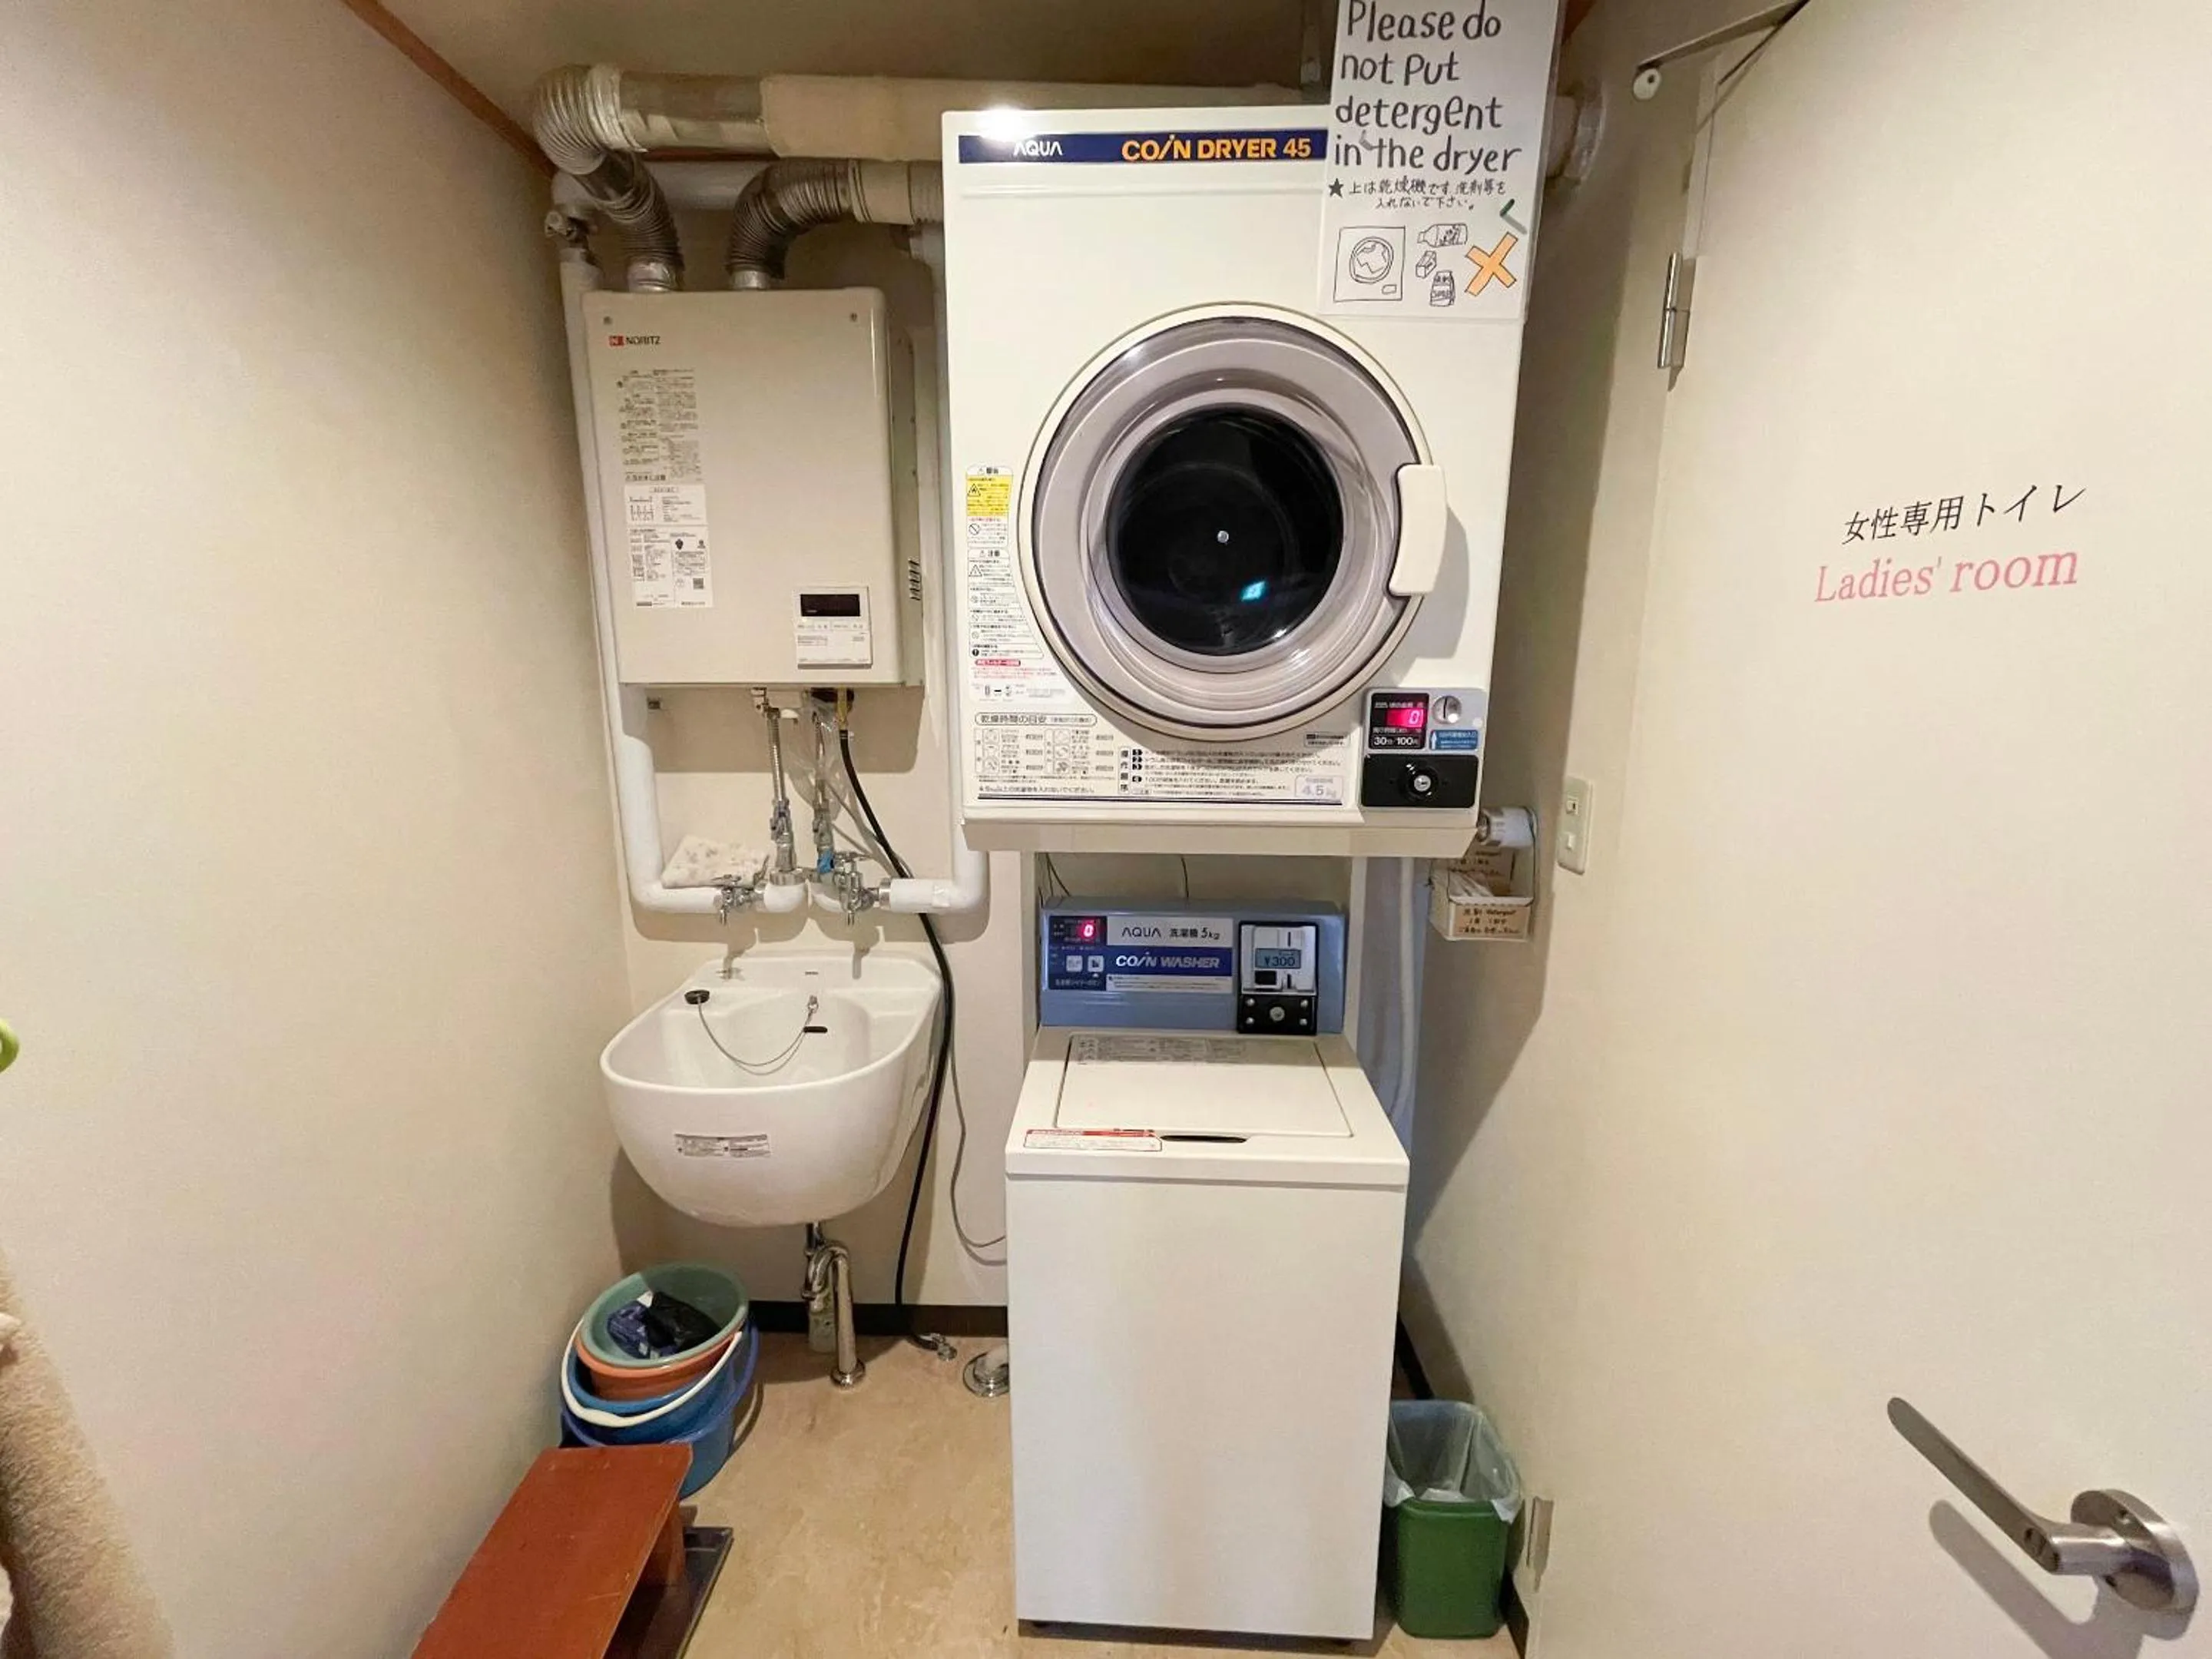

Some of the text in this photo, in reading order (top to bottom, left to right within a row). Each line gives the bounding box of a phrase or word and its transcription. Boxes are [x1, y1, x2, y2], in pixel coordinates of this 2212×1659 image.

[1347, 0, 1502, 41] Please do
[1341, 53, 1395, 84] not
[1335, 95, 1503, 134] detergent
[1012, 134, 1311, 161] AQUA COIN DRYER 45
[1334, 134, 1522, 175] in the dryer
[626, 336, 661, 346] NORITZ
[1842, 485, 2086, 545] 女性専用トイレ
[1814, 551, 2078, 602] Ladies' room
[1409, 710, 1420, 724] 0
[1121, 927, 1161, 937] AQUA
[1116, 952, 1220, 969] COIN WASHER
